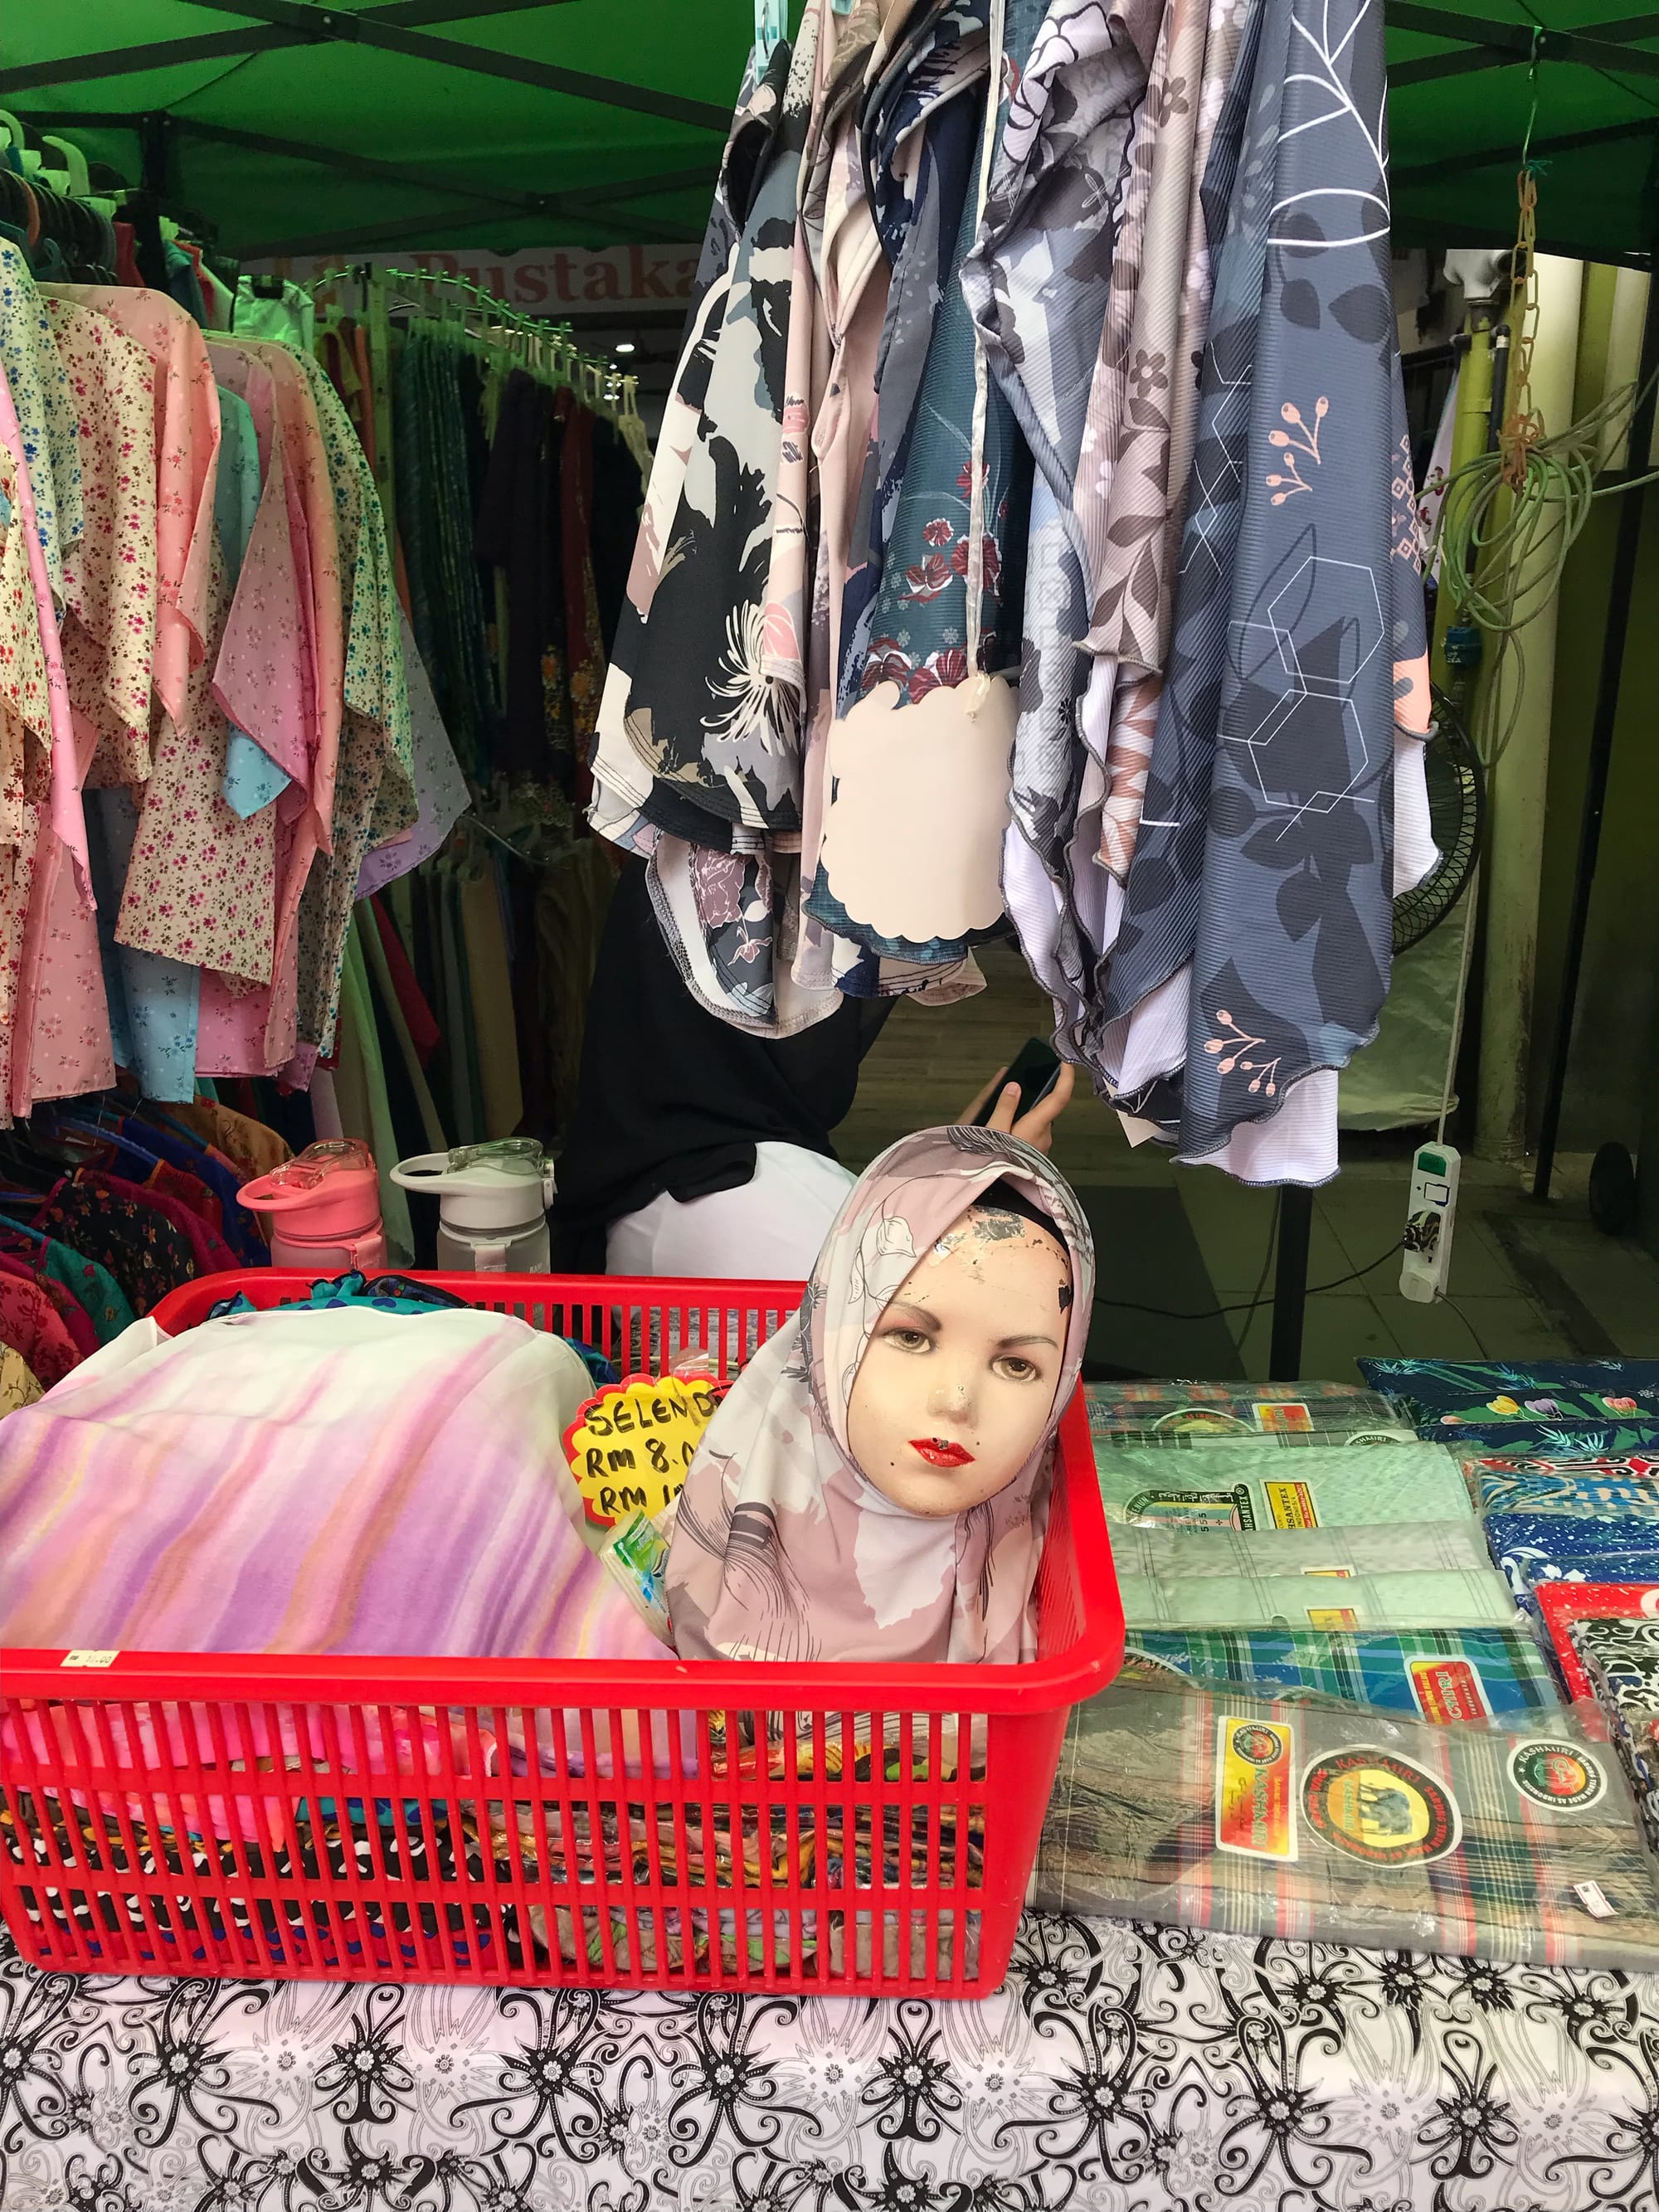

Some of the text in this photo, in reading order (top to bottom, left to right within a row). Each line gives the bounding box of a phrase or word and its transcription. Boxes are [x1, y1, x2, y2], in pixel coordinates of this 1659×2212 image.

[584, 1386, 730, 1437] SELEND
[1355, 1436, 1387, 1445] SHMIRI
[586, 1447, 636, 1478] RM
[599, 1485, 647, 1516] RM
[1278, 1487, 1296, 1529] HSANTEX
[1435, 1671, 1463, 1721] CHIRI
